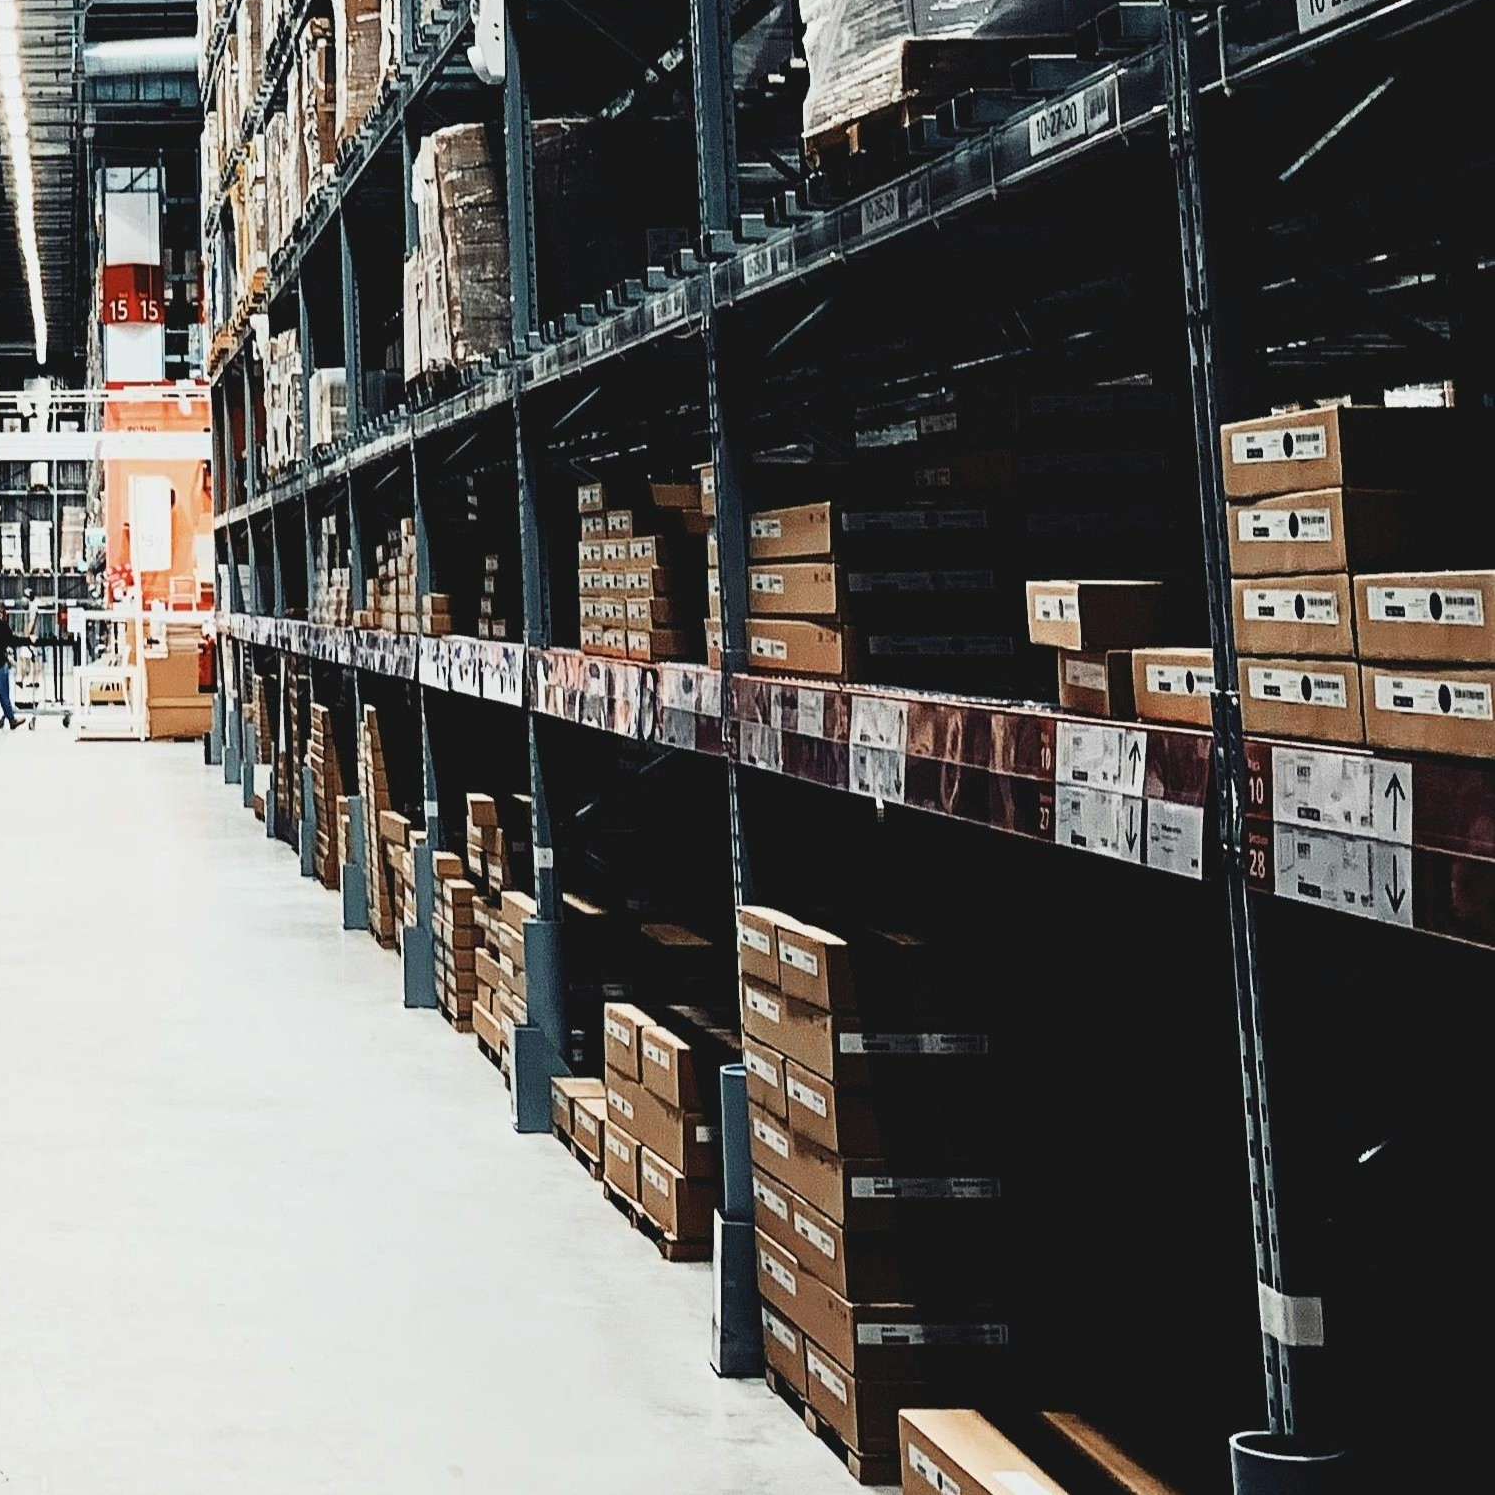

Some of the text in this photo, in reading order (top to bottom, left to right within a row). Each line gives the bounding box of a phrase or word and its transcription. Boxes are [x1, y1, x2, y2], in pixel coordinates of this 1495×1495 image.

[1036, 101, 1078, 143] 10-27-20
[109, 299, 128, 320] 15
[140, 299, 159, 320] 15
[1248, 776, 1264, 805] 10
[1249, 849, 1266, 879] 28
